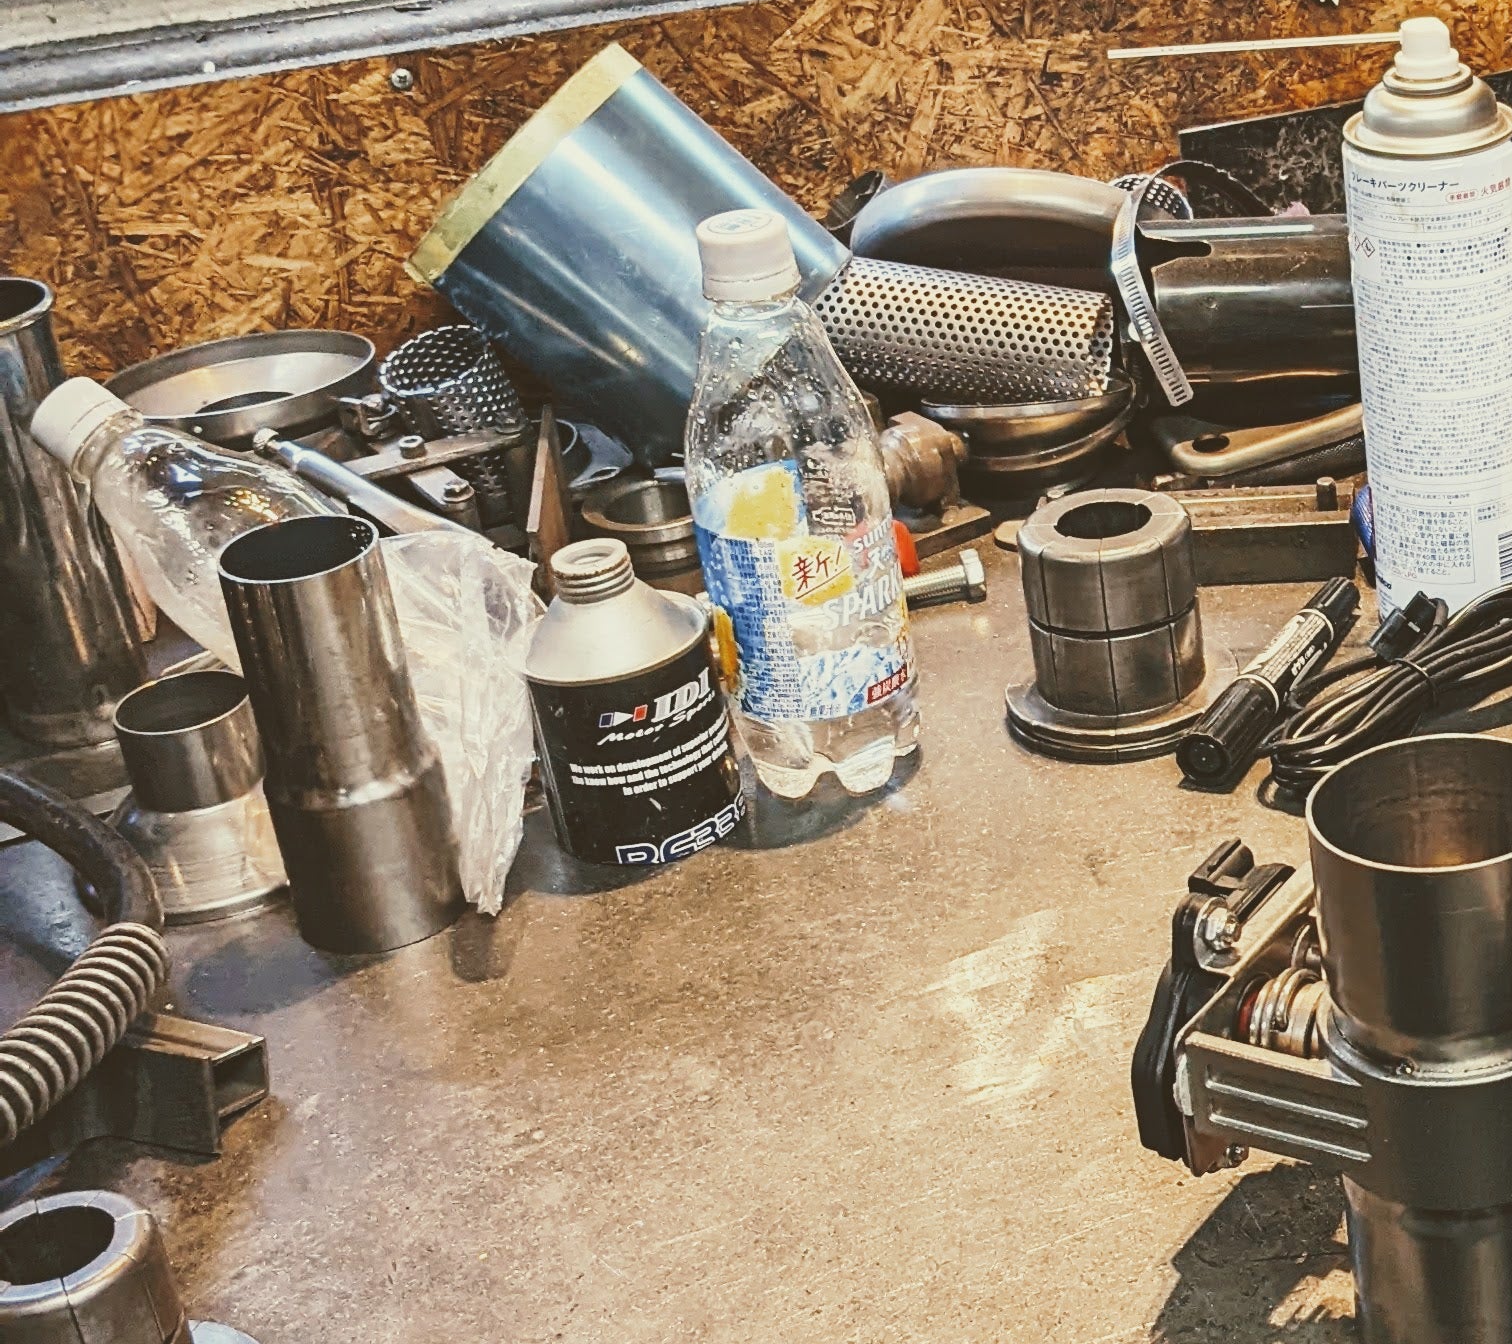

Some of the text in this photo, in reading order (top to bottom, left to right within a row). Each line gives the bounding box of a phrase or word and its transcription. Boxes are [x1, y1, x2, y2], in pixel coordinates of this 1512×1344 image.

[651, 667, 711, 724] IDI
[597, 723, 665, 746] Motor
[583, 764, 605, 775] work
[616, 749, 673, 773] development
[584, 777, 607, 786] know
[626, 771, 645, 783] and
[643, 768, 660, 780] the
